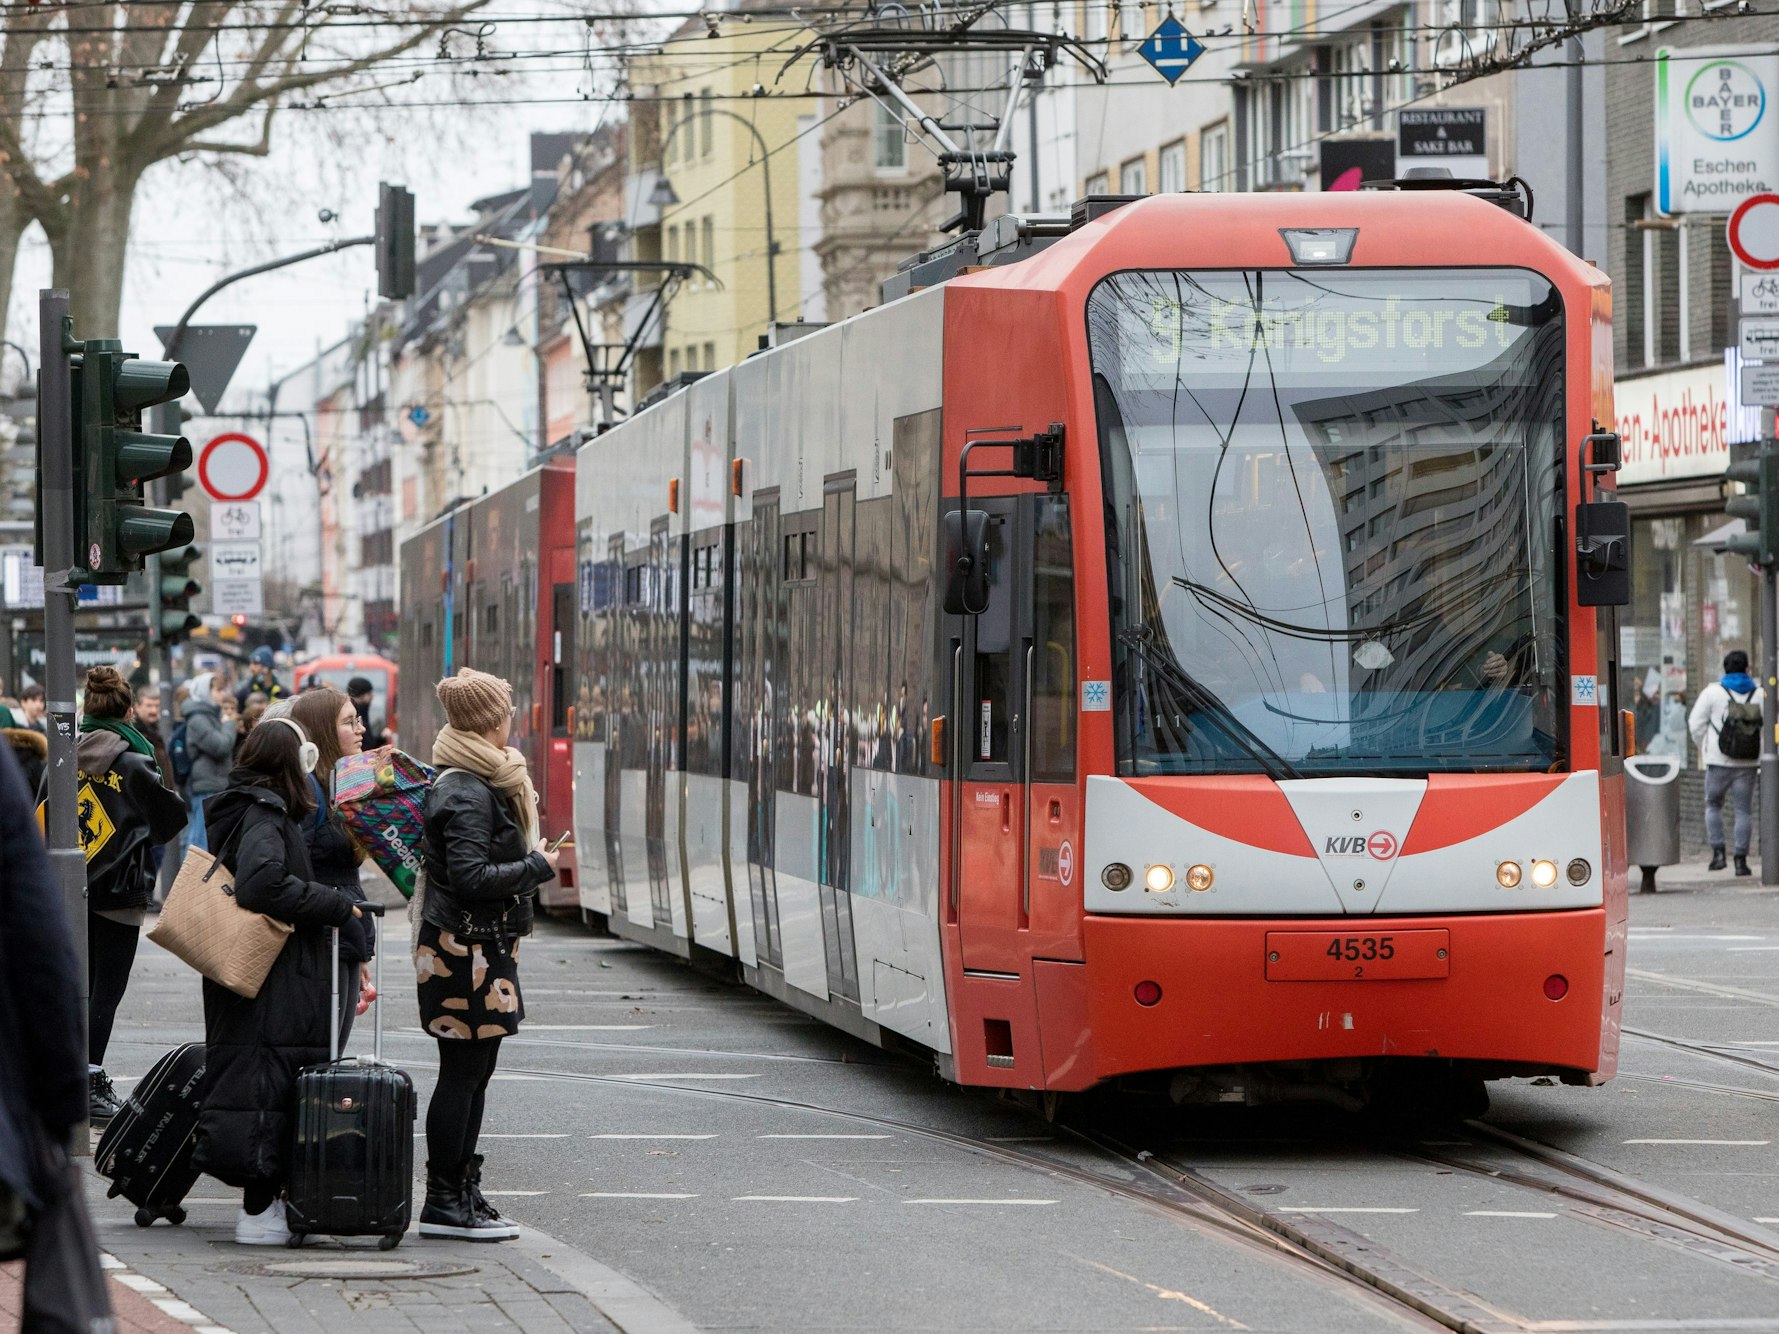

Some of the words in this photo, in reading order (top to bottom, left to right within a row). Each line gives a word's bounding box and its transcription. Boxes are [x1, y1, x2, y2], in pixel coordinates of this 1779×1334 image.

[1692, 94, 1759, 108] BAYER
[1401, 111, 1481, 125] RESTAURANT
[1414, 140, 1445, 153] SAKE
[1447, 140, 1473, 153] BAR
[1693, 159, 1757, 174] Eschen
[1684, 179, 1766, 198] Apotheke
[1760, 300, 1778, 309] frei
[1210, 294, 1510, 363] Königsforst
[1760, 345, 1778, 354] frei
[1325, 837, 1367, 853] KVB
[1327, 937, 1395, 961] 4535
[1354, 966, 1364, 978] 2
[135, 1111, 175, 1164] TRAVELLER
